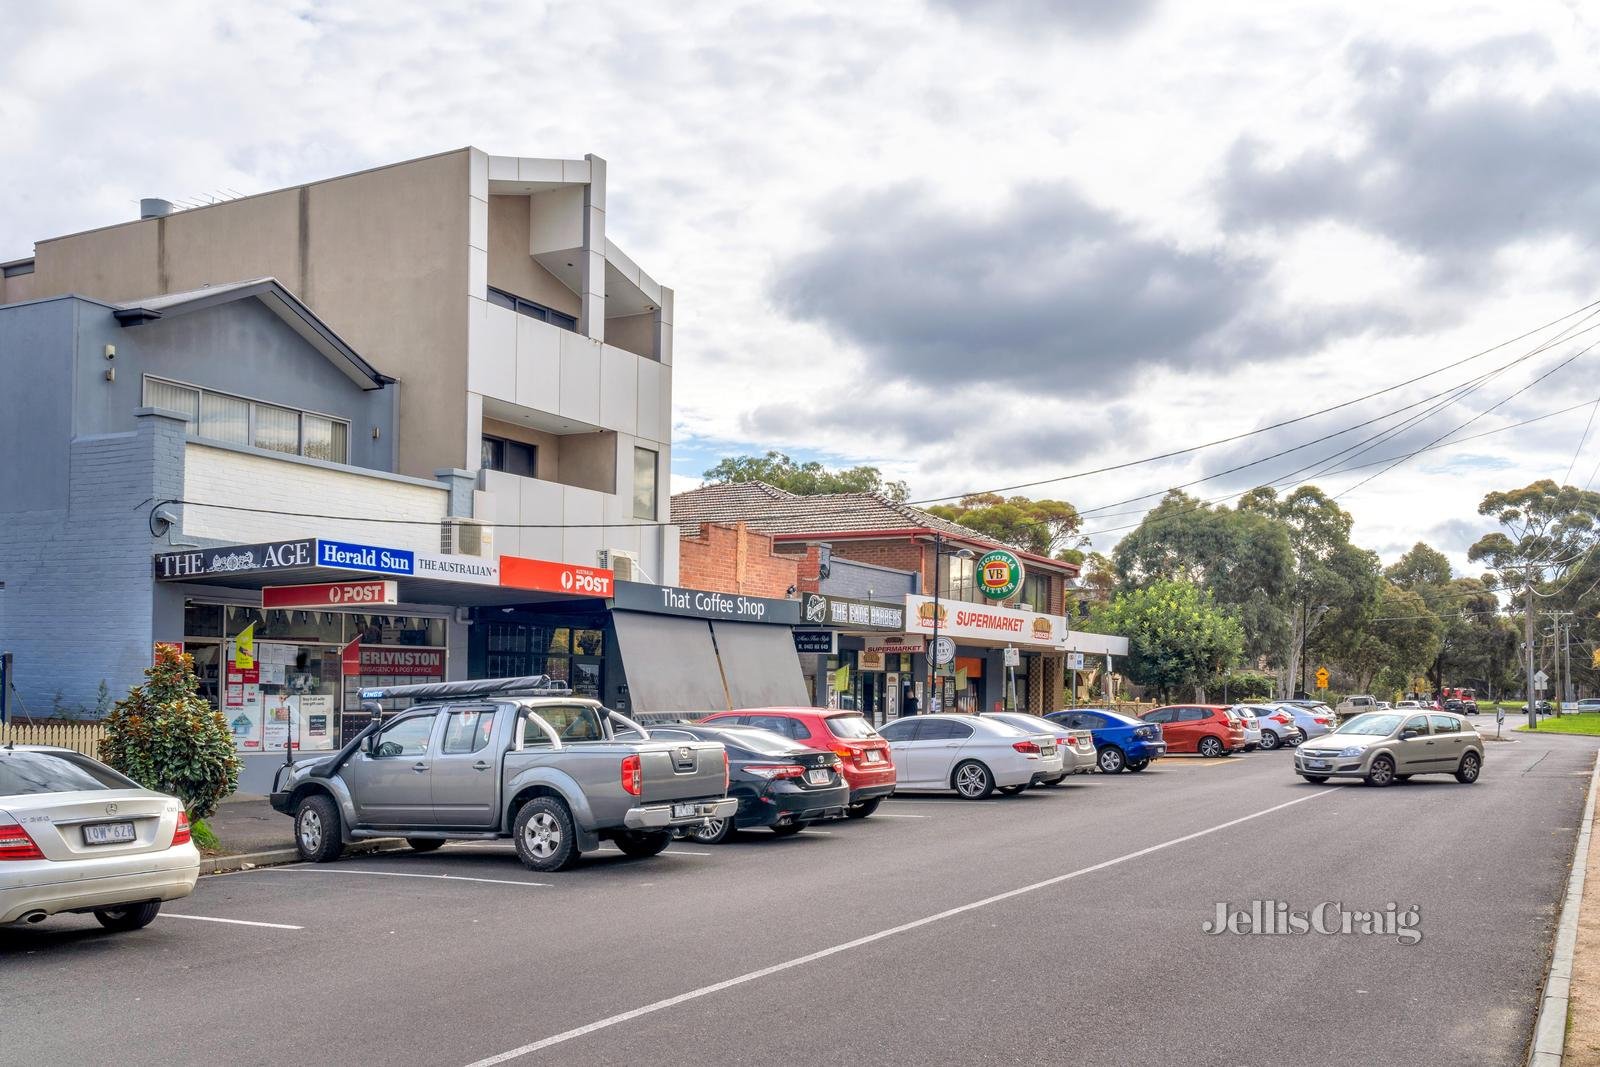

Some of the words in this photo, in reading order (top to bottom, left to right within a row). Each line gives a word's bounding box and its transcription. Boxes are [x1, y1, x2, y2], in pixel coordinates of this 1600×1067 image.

[160, 552, 204, 577] THE
[262, 543, 310, 568] AGE
[323, 544, 376, 567] Herald
[380, 552, 409, 570] Sun
[978, 555, 1016, 571] VICTORIA
[419, 559, 437, 571] THE
[438, 561, 492, 577] AUSTRALIAN
[988, 569, 1003, 579] VB
[575, 574, 609, 593] POST
[980, 583, 1014, 594] BITTER
[343, 586, 381, 601] POST
[662, 588, 690, 609] That
[695, 593, 734, 613] Coffee
[737, 597, 764, 620] Shop
[956, 611, 1024, 632] SUPERMARKET
[360, 651, 440, 666] ERLYNSTON
